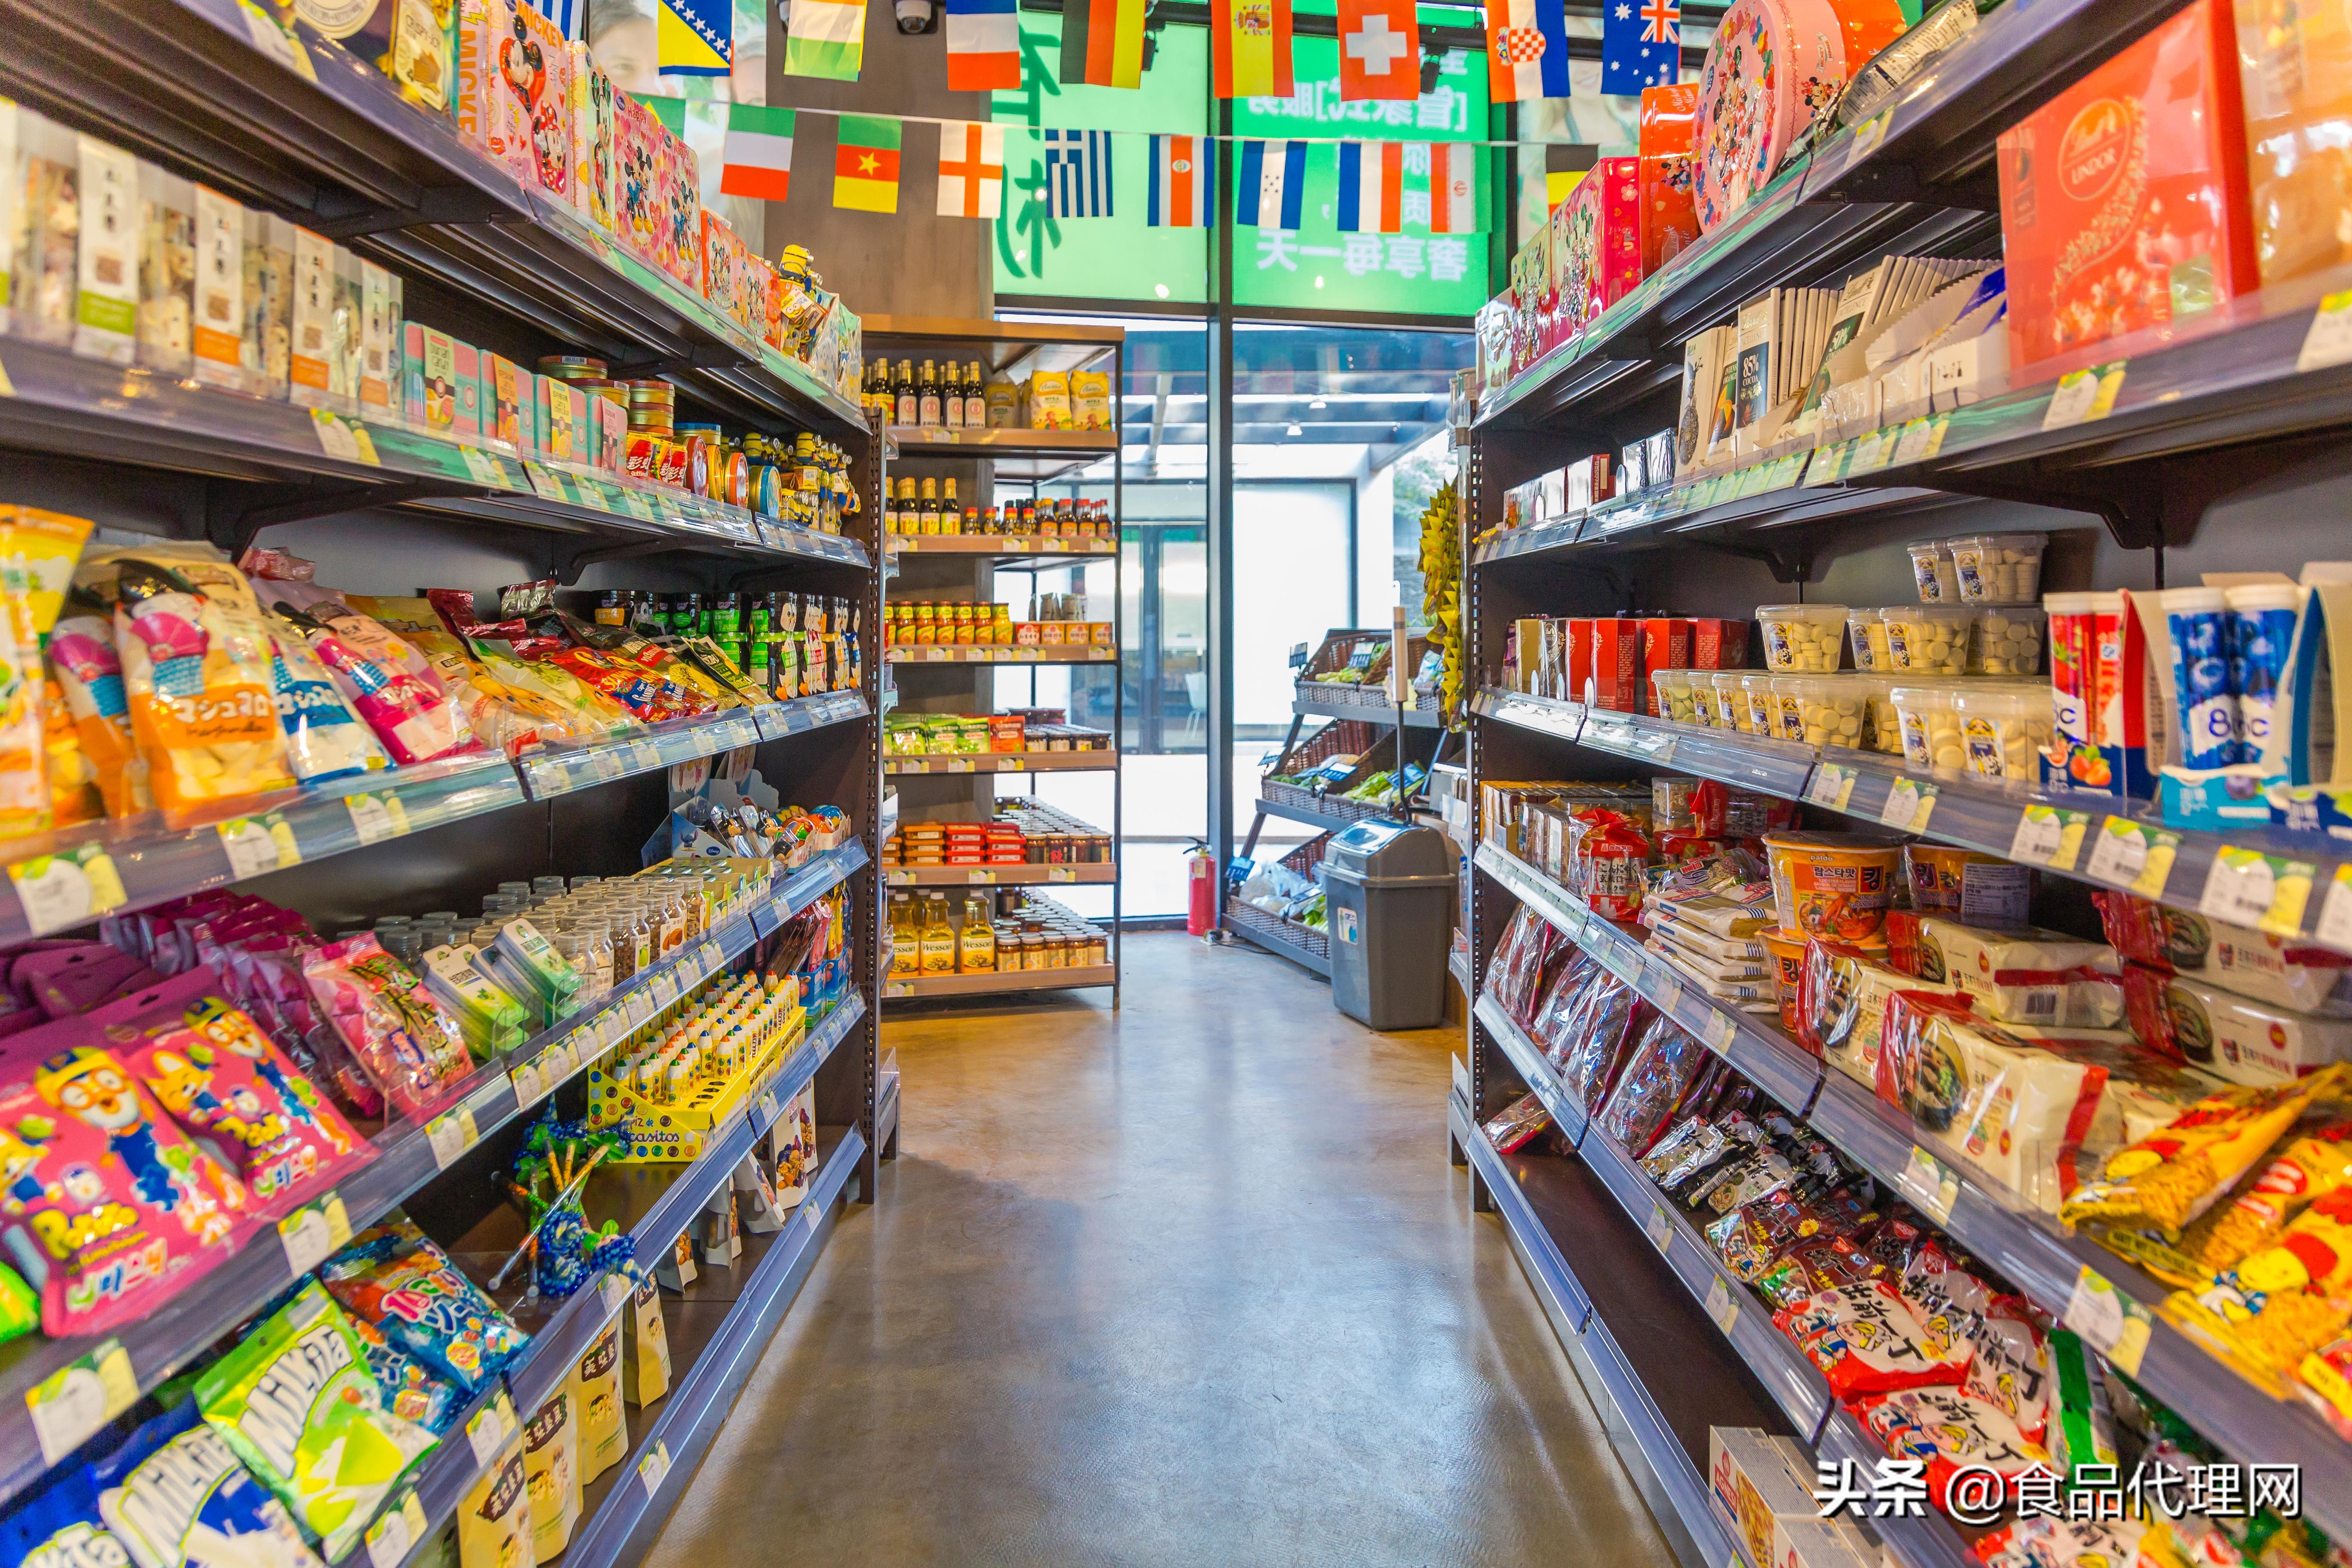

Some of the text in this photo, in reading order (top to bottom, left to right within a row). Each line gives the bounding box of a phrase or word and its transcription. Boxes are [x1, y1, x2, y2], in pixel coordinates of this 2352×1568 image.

[516, 1, 565, 51] MICKEY
[1825, 39, 1833, 59] MINNIE
[459, 30, 478, 137] MICKE
[627, 106, 647, 124] Happy
[673, 144, 689, 159] Happy
[2070, 147, 2117, 186] LINDOR
[1743, 353, 1759, 378] 85%
[1742, 375, 1759, 386] COCOA
[174, 690, 270, 724] マシュマロ
[1813, 867, 1856, 878] 랍스타맛
[1863, 867, 1880, 891] 킹
[893, 945, 916, 953] esson
[922, 943, 952, 951] Wesson
[962, 937, 994, 949] Wesson
[645, 1117, 655, 1128] de
[630, 1130, 680, 1143] casitos
[1838, 1283, 1925, 1363] 出前一丁
[1715, 1464, 1736, 1512] AGNESI
